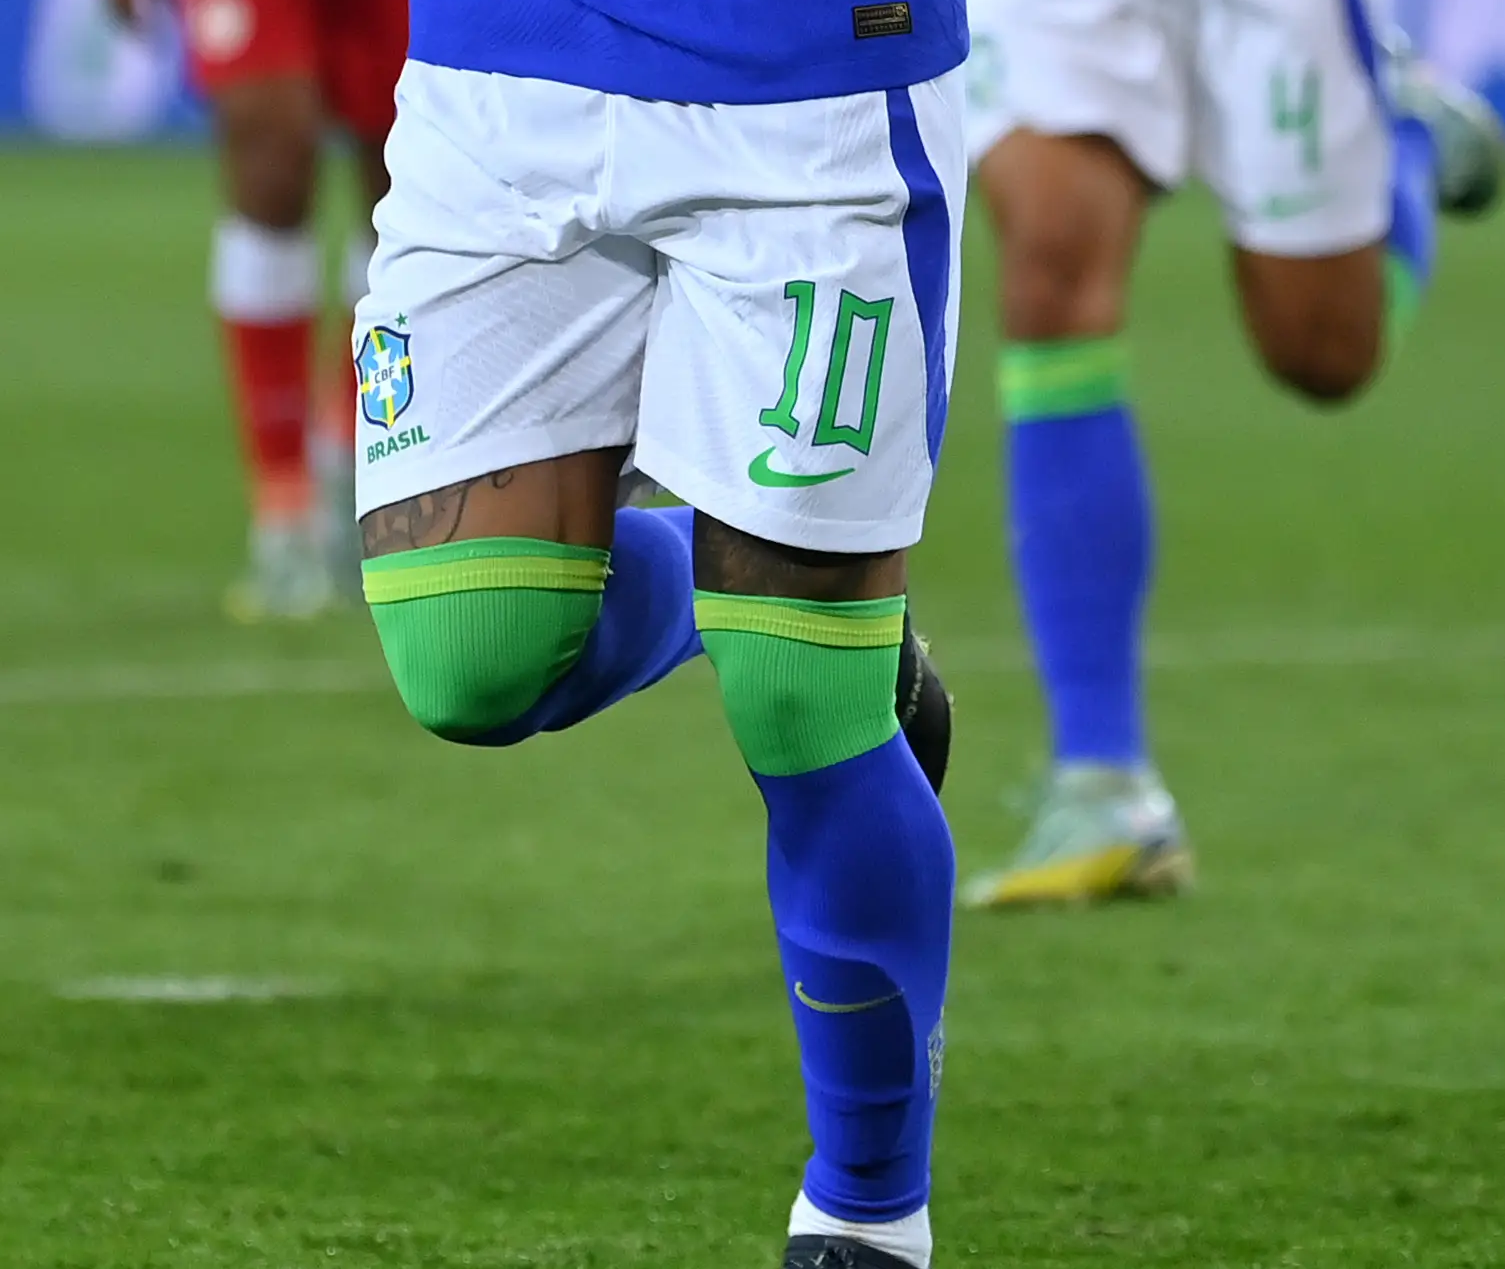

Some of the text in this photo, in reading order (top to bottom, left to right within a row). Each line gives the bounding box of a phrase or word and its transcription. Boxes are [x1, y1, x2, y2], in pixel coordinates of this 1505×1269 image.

[1268, 62, 1322, 171] 4
[374, 366, 395, 384] CBF
[758, 279, 895, 456] 10
[367, 425, 431, 464] BRASIL
